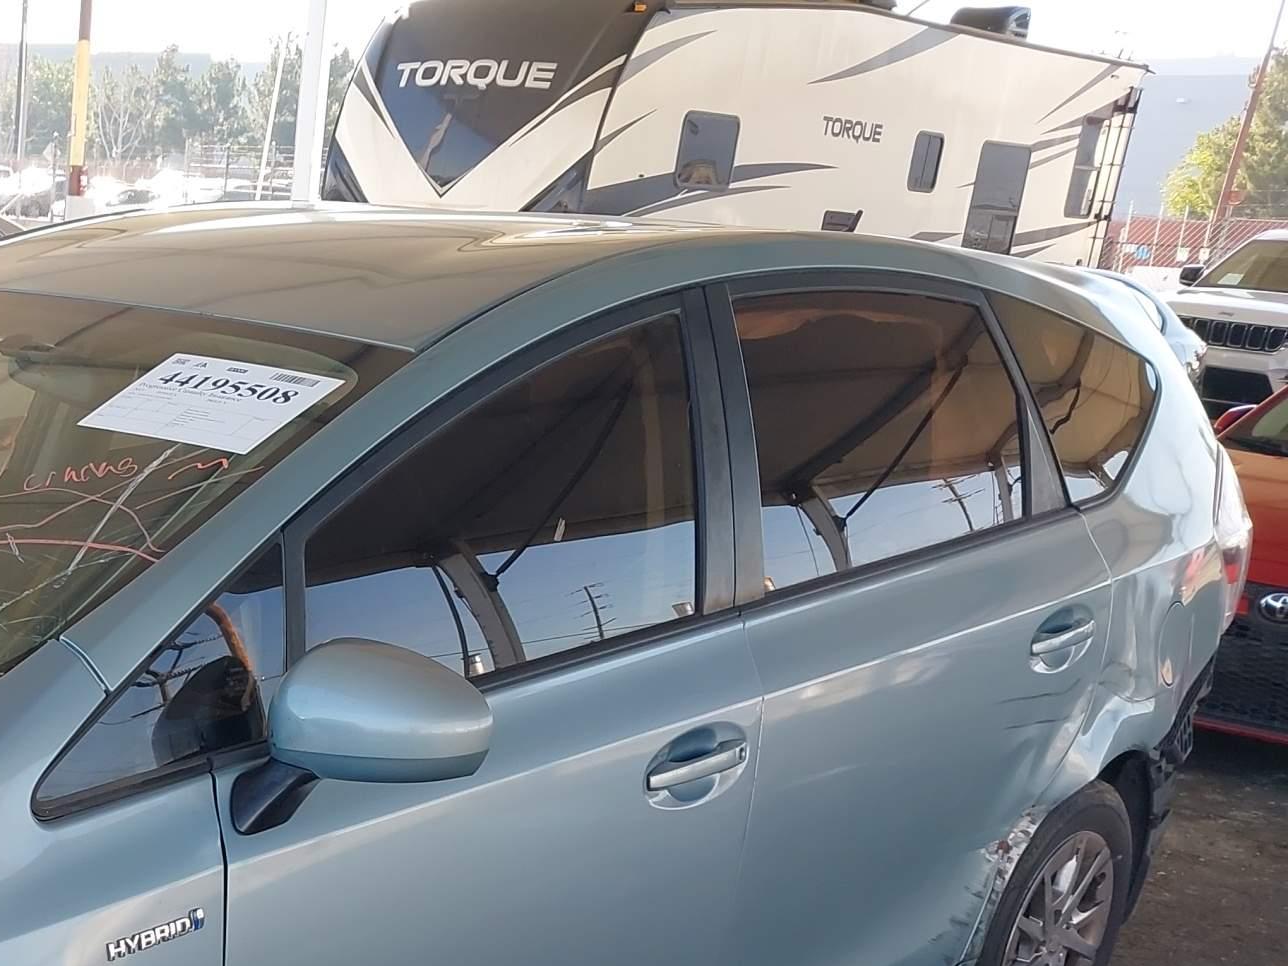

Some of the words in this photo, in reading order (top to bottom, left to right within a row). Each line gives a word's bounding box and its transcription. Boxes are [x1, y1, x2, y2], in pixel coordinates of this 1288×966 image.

[397, 59, 558, 90] TORQUE
[823, 115, 883, 143] TORQUE
[159, 371, 299, 404] 44195508
[106, 916, 192, 961] HYBRID
